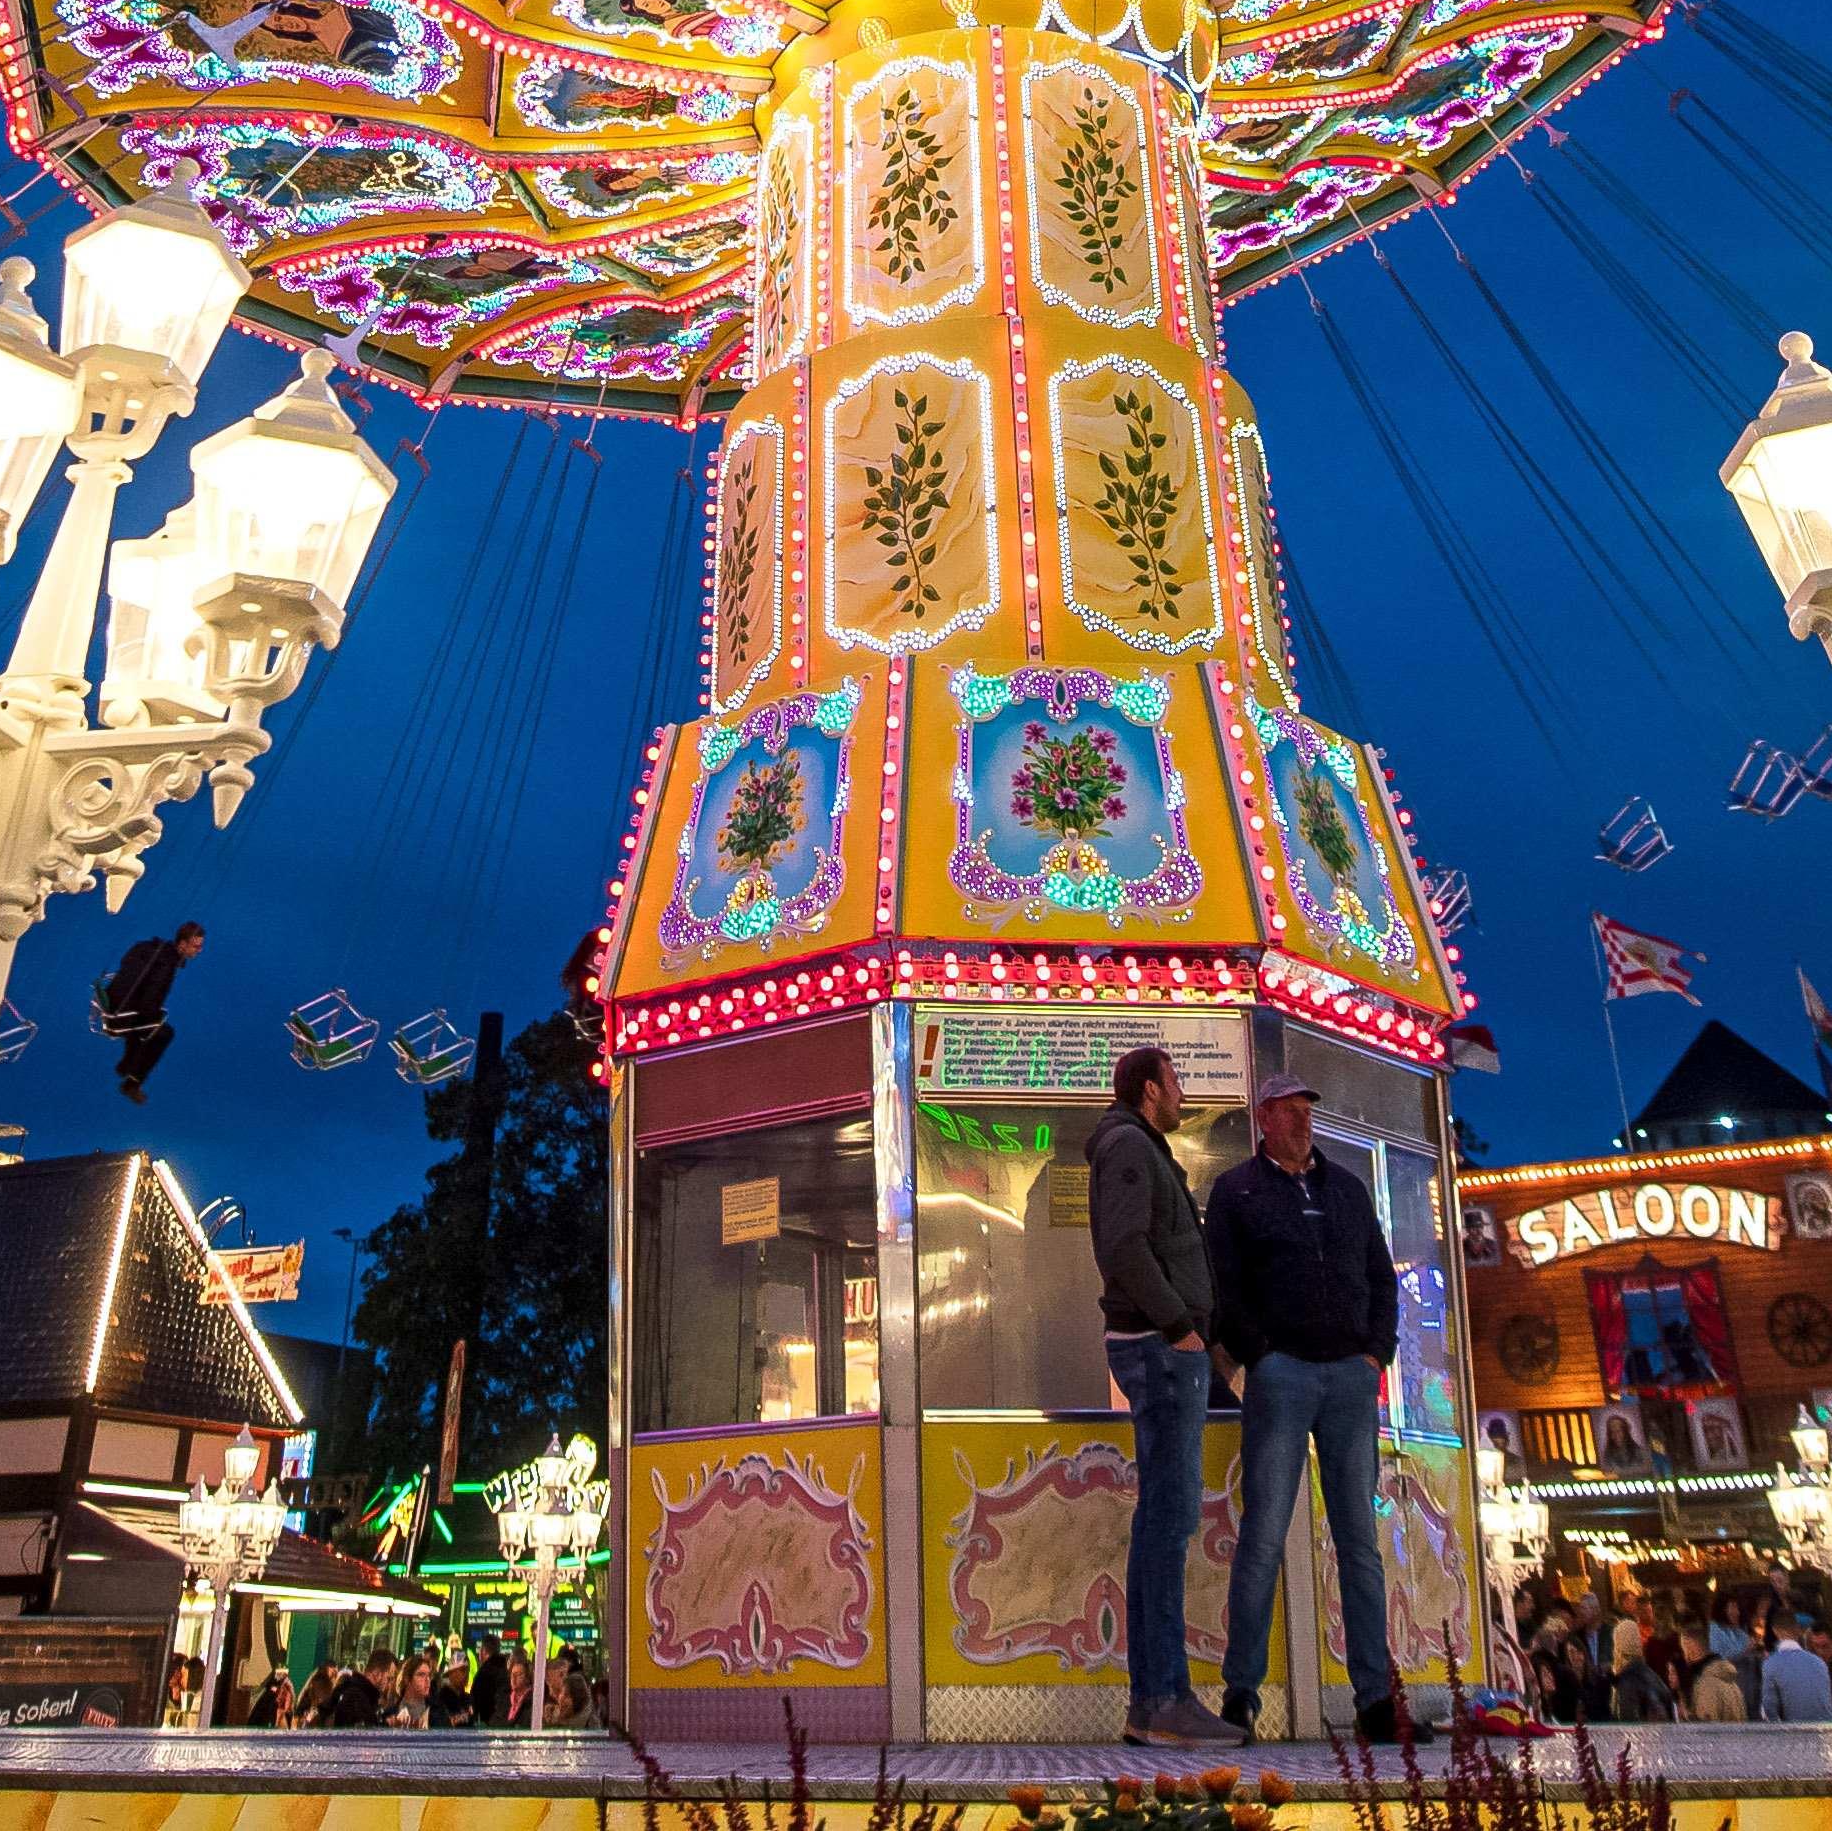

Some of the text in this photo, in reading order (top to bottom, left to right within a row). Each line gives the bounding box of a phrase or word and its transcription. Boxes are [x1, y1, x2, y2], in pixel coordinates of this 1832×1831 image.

[1015, 1019, 1046, 1027] Jahren
[1048, 1020, 1080, 1028] dürfen
[1060, 1040, 1087, 1048] sowie
[1172, 1051, 1191, 1059] und
[1518, 1182, 1768, 1265] SALOON
[14, 1689, 78, 1724] Soßen!
